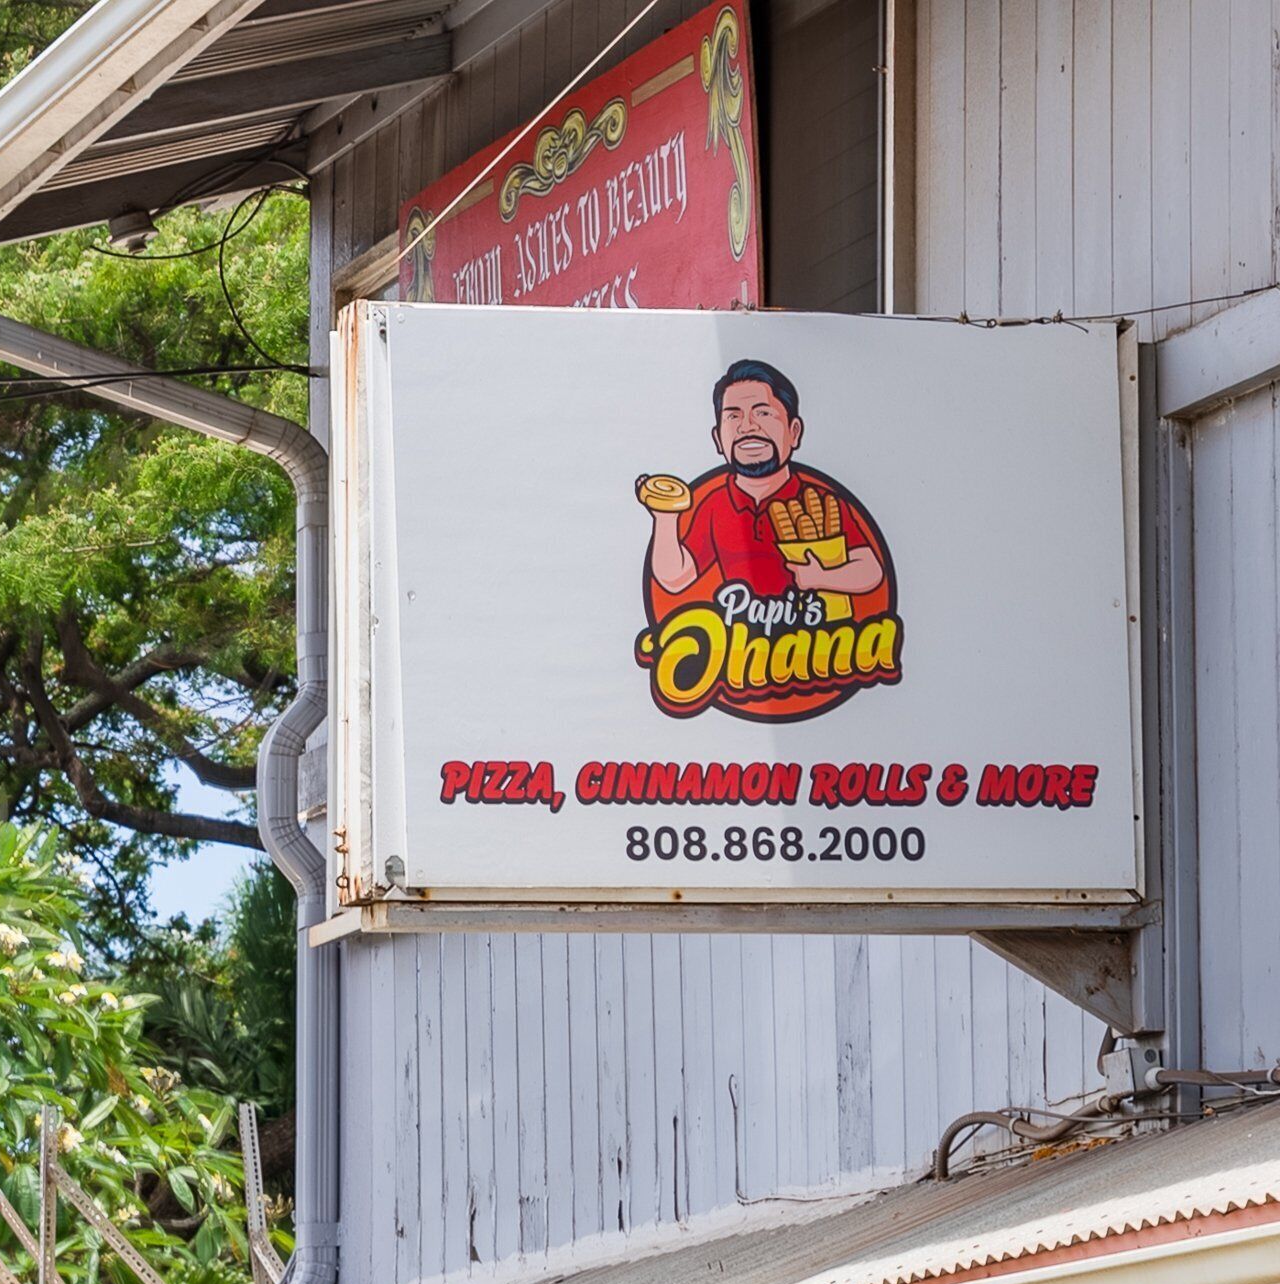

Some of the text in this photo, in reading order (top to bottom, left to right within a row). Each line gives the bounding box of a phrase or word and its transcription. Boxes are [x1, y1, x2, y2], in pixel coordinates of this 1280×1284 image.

[514, 202, 573, 297] ASHES
[577, 187, 600, 256] TO
[605, 130, 687, 247] BEAUTY
[717, 583, 822, 637] Papi's
[441, 761, 1098, 814] PIZZA, CINNAMON ROLLS & MORE
[626, 826, 926, 861] 808.868.2000
